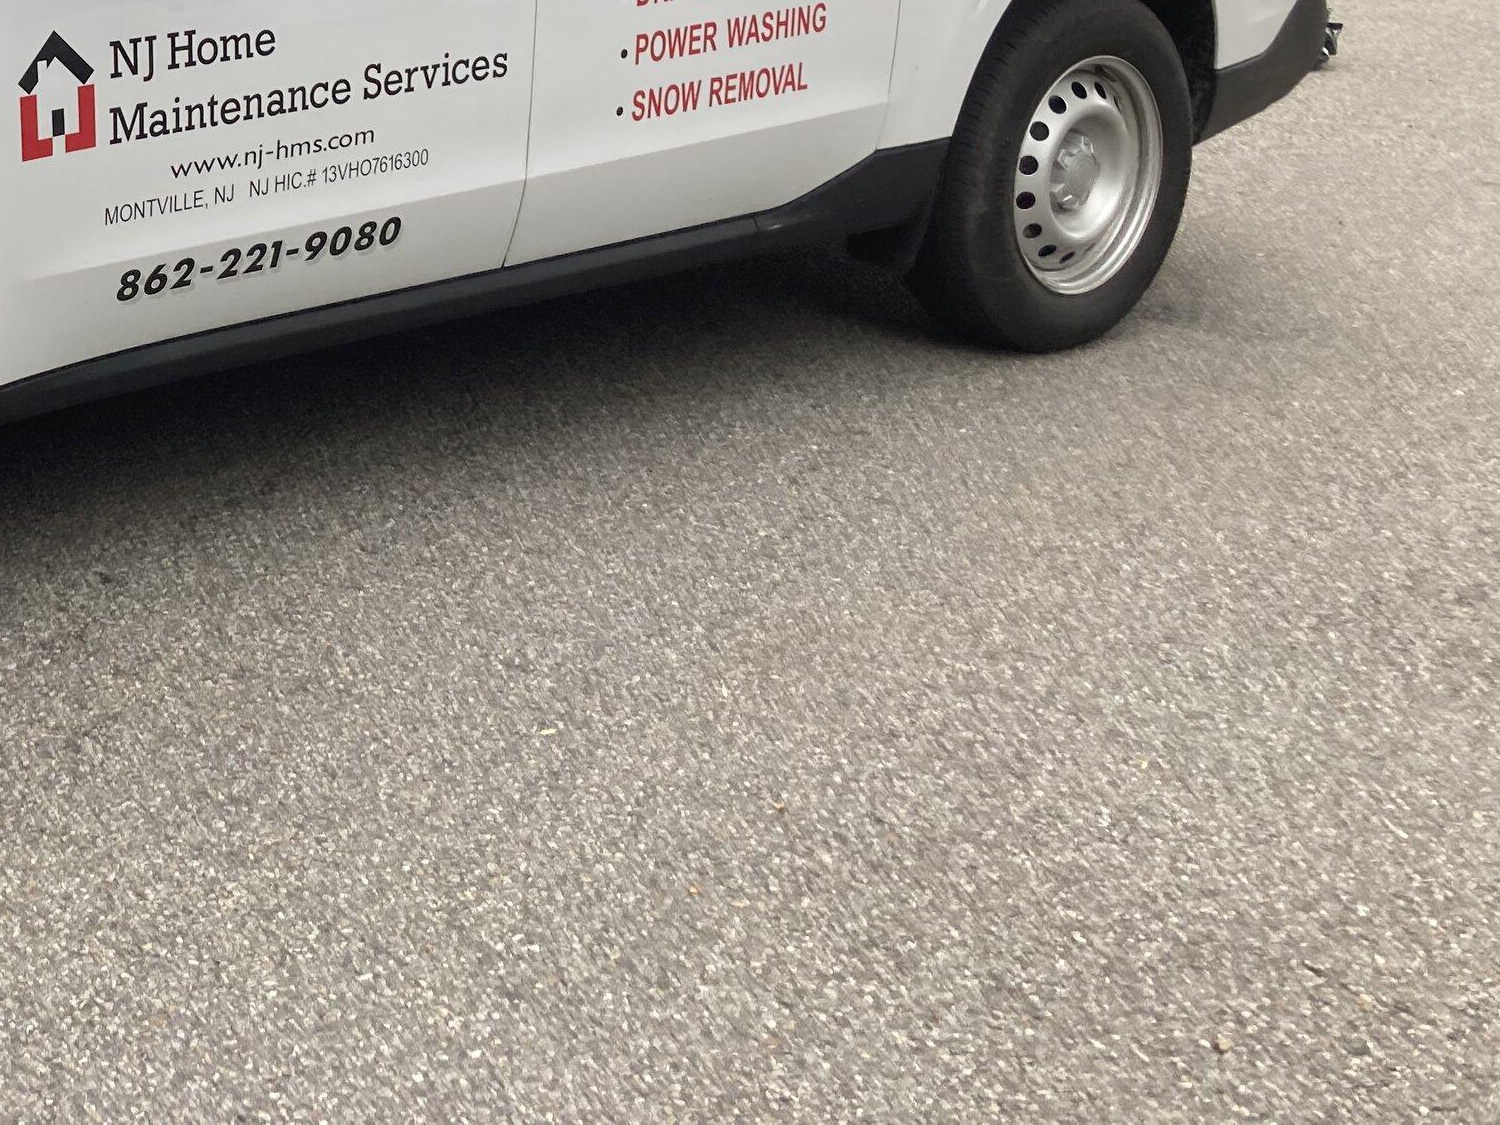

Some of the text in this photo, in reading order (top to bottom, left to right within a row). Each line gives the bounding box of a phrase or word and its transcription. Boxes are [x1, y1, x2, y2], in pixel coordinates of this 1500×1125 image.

[109, 29, 276, 82] NJ Home
[635, 2, 827, 65] POWER WASHING
[109, 52, 508, 145] Maintenance Services
[631, 62, 808, 122] SNOW REMOVAL
[170, 129, 376, 179] www.nj-hms.com
[104, 189, 209, 226] MONTVILLE,
[214, 184, 235, 204] NJ
[249, 177, 270, 198] NJ
[116, 216, 404, 303] 862-221-9080
